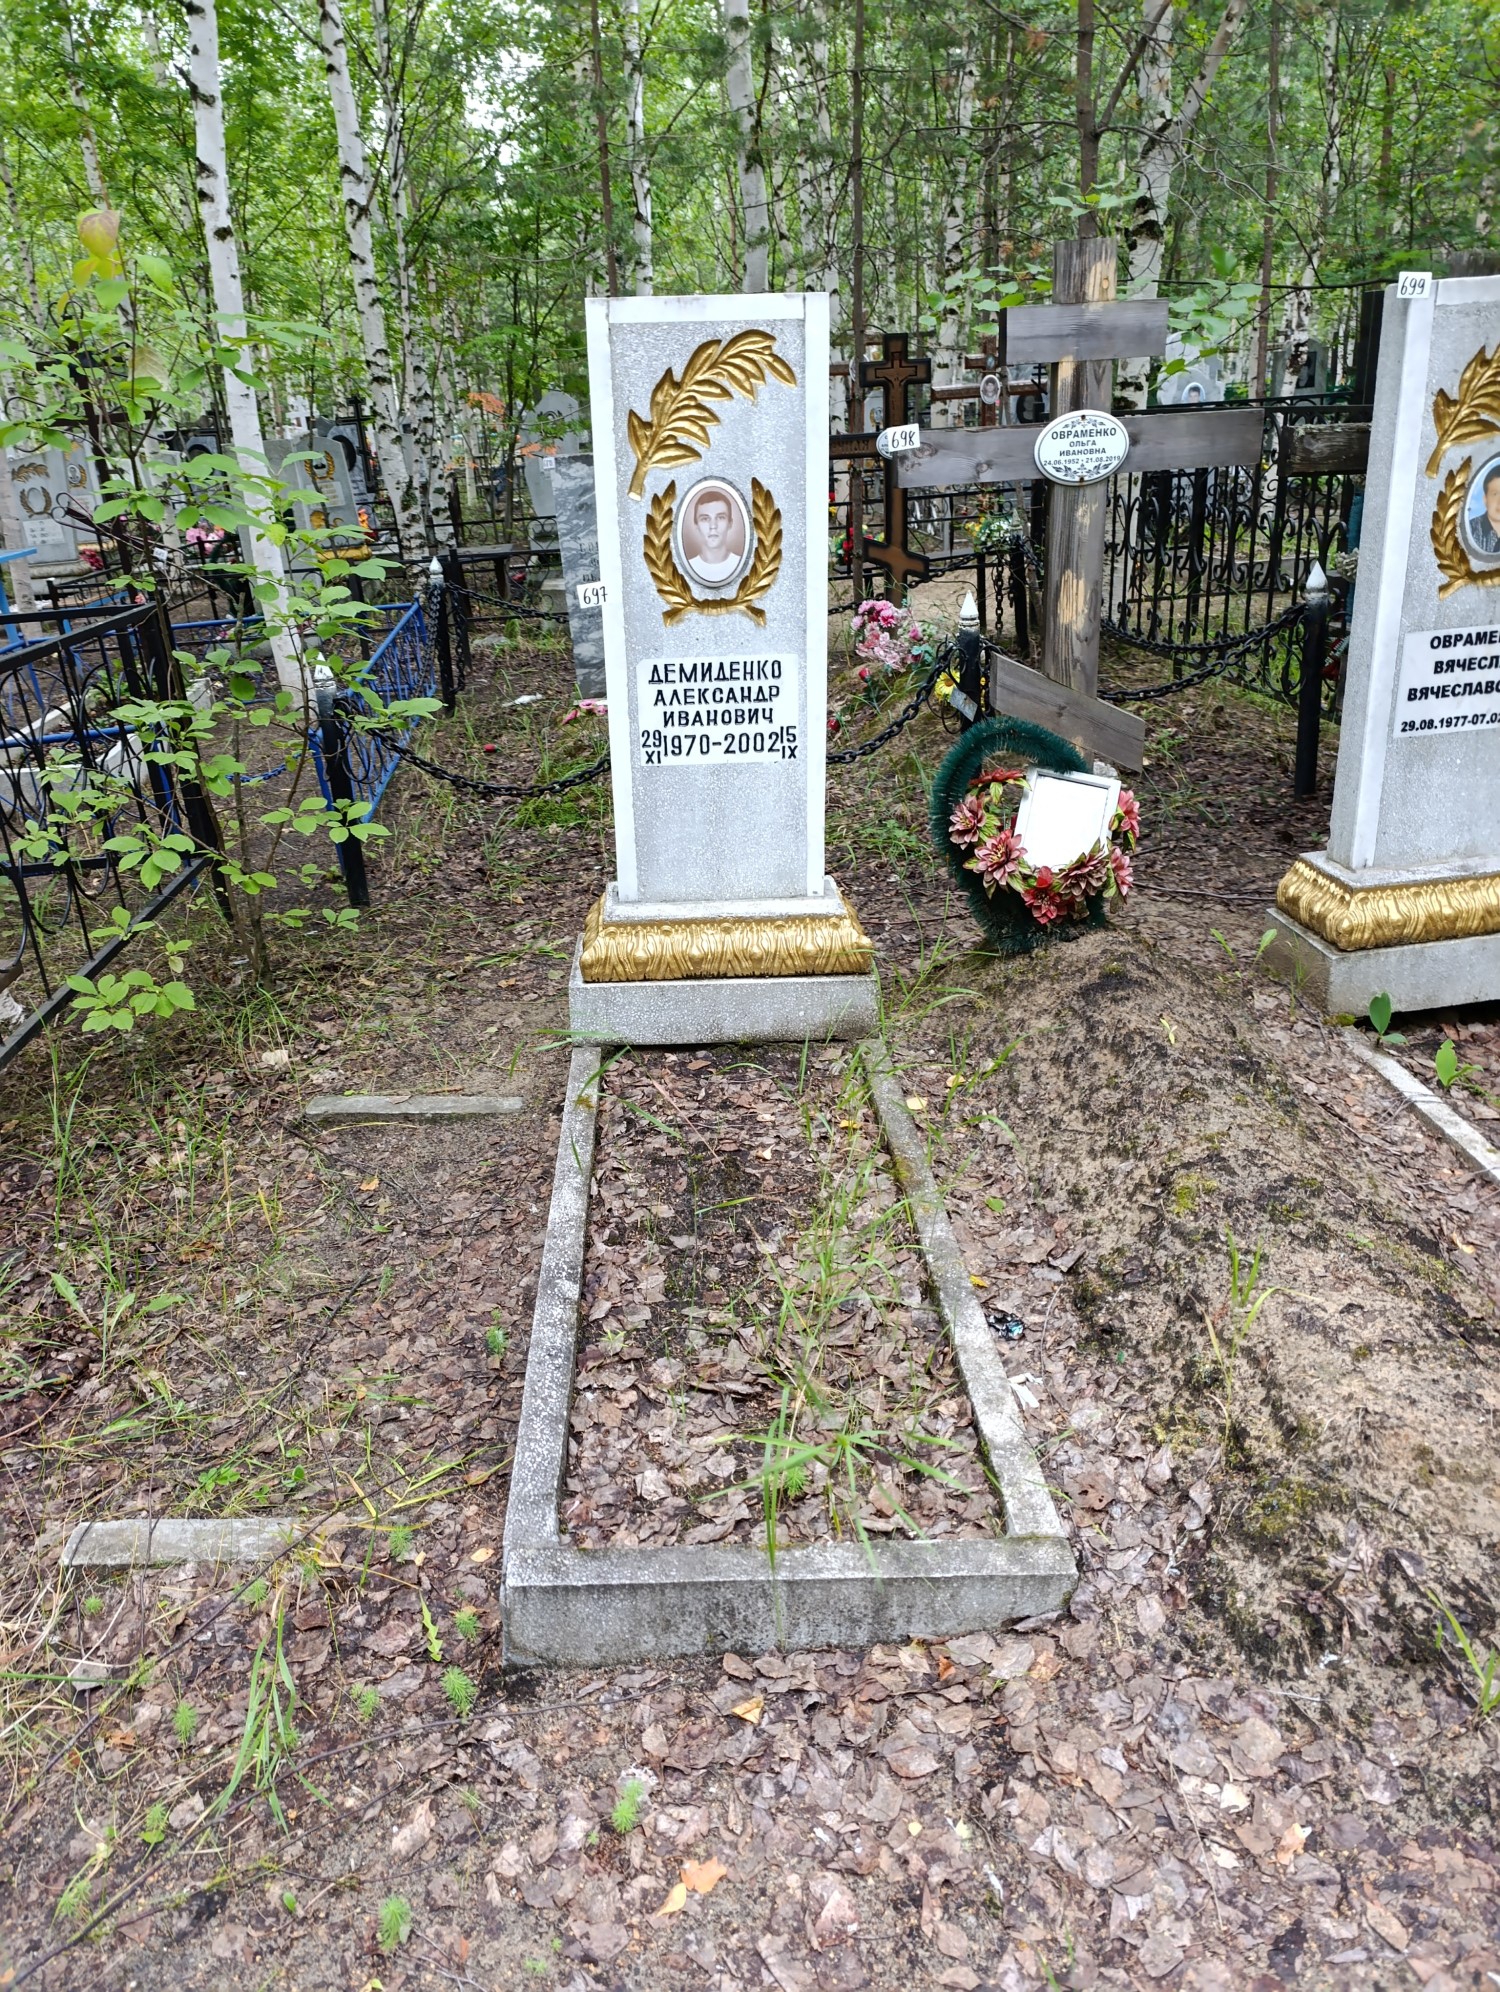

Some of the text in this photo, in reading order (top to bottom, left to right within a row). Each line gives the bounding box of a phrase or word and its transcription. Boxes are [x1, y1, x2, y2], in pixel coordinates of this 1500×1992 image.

[1400, 276, 1425, 295] 699
[891, 430, 916, 448] 698
[1051, 427, 1117, 440] ОВРАМЕНКО
[1059, 448, 1106, 457] ИВАНОВНА
[1069, 440, 1097, 448] ОЛЬГА
[583, 585, 608, 605] 697
[1430, 630, 1500, 650] ОВРАМЕ
[648, 659, 782, 685] ДЕМИДЕНКО
[1433, 655, 1500, 675] ВЯЧЕСЛ
[653, 685, 780, 707] АЛЕКСАНДР
[662, 708, 774, 728] ИВАНОВИЧ
[641, 726, 797, 757] 29 1970-2002 15
